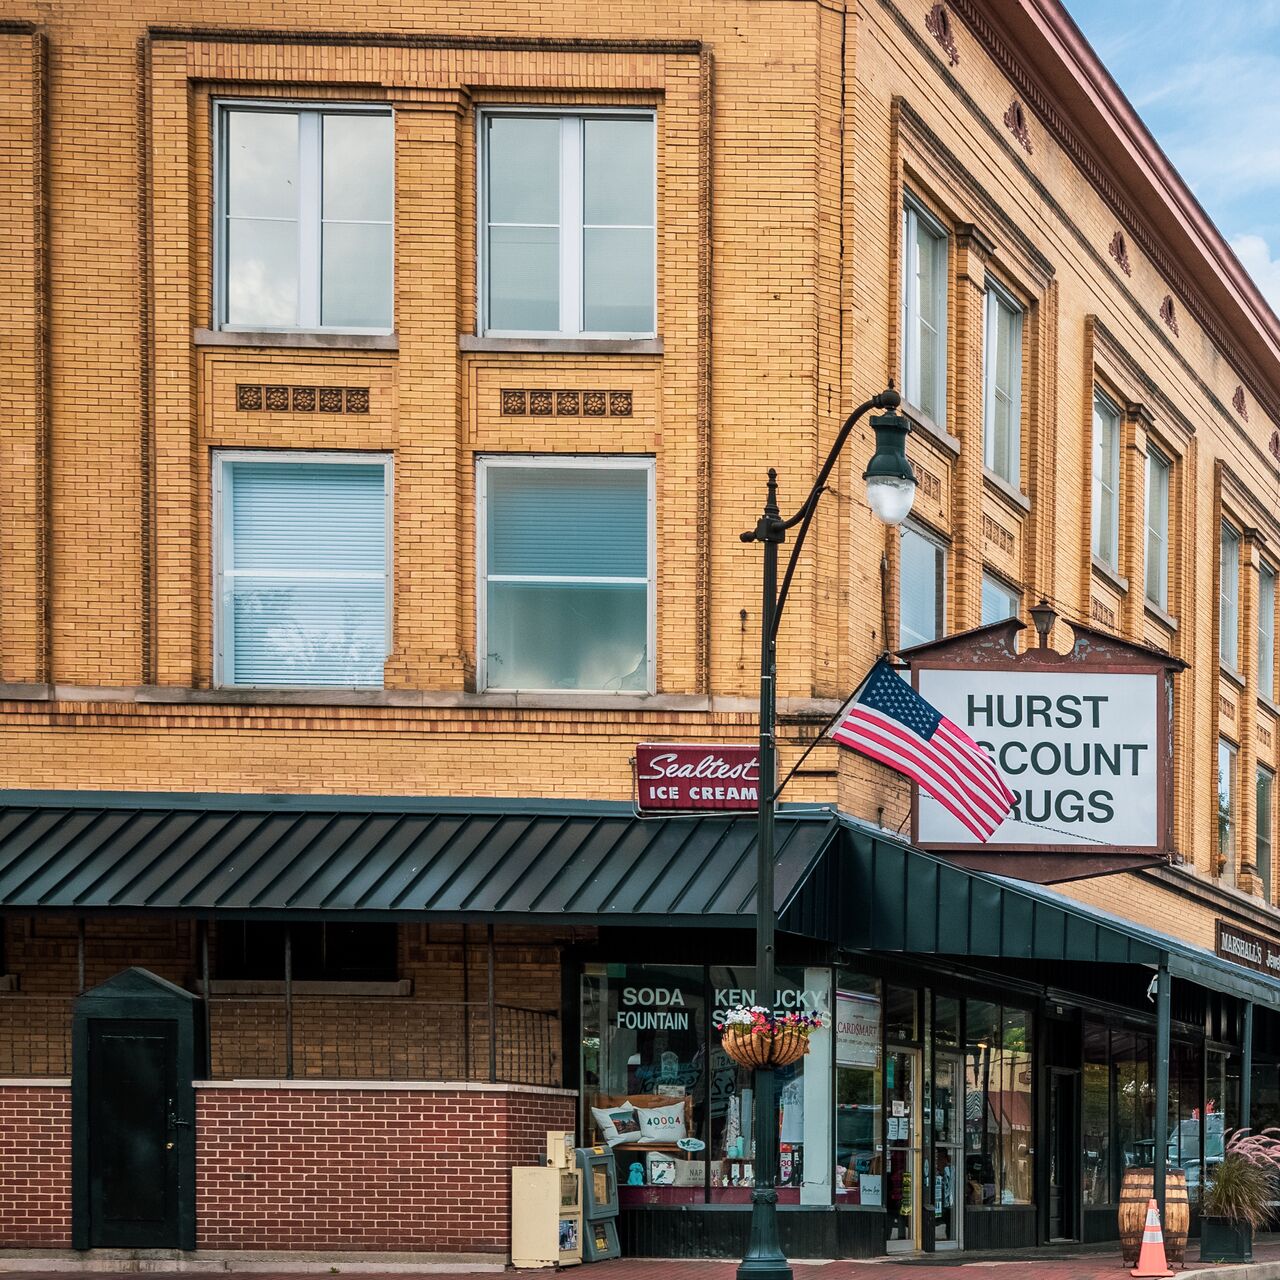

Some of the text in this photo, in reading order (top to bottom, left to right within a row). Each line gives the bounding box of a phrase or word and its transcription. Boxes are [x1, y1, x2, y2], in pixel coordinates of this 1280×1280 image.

[967, 694, 1109, 729] HURST
[639, 753, 760, 781] Sealtest
[975, 740, 1149, 777] COUNT
[649, 786, 759, 801] ICE CREAM
[1009, 788, 1115, 824] UGS
[1221, 931, 1262, 965] MARSHALL'S
[622, 987, 685, 1006] SODA
[714, 988, 824, 1008] KENUCKY
[617, 1011, 689, 1031] FOUNTAIN
[647, 1116, 681, 1126] 40004
